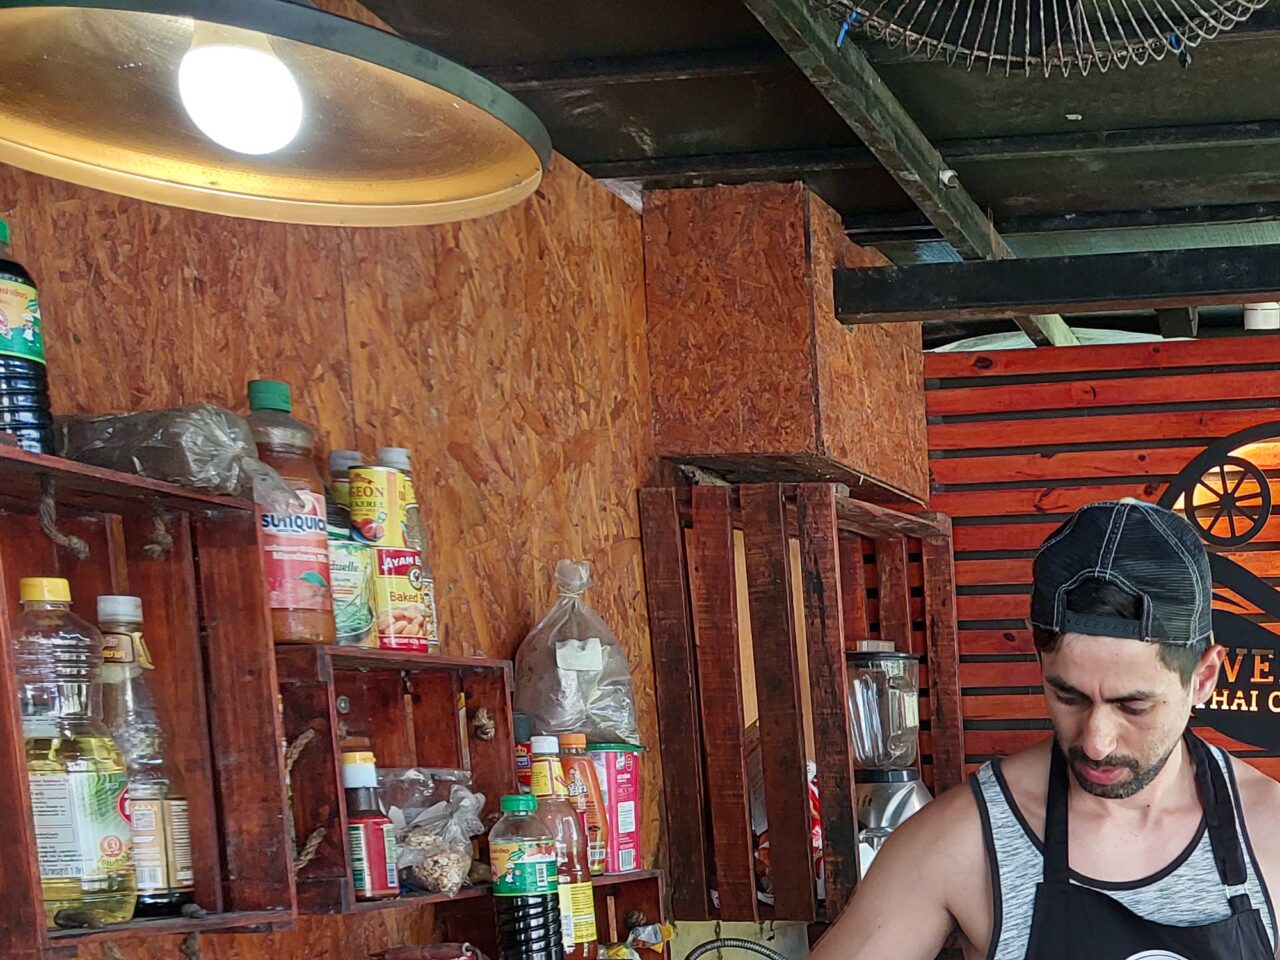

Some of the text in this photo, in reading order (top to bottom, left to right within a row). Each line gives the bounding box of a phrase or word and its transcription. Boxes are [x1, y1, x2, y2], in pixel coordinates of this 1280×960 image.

[382, 556, 414, 570] AYAM
[389, 591, 418, 603] Baked
[1195, 687, 1260, 712] HAI
